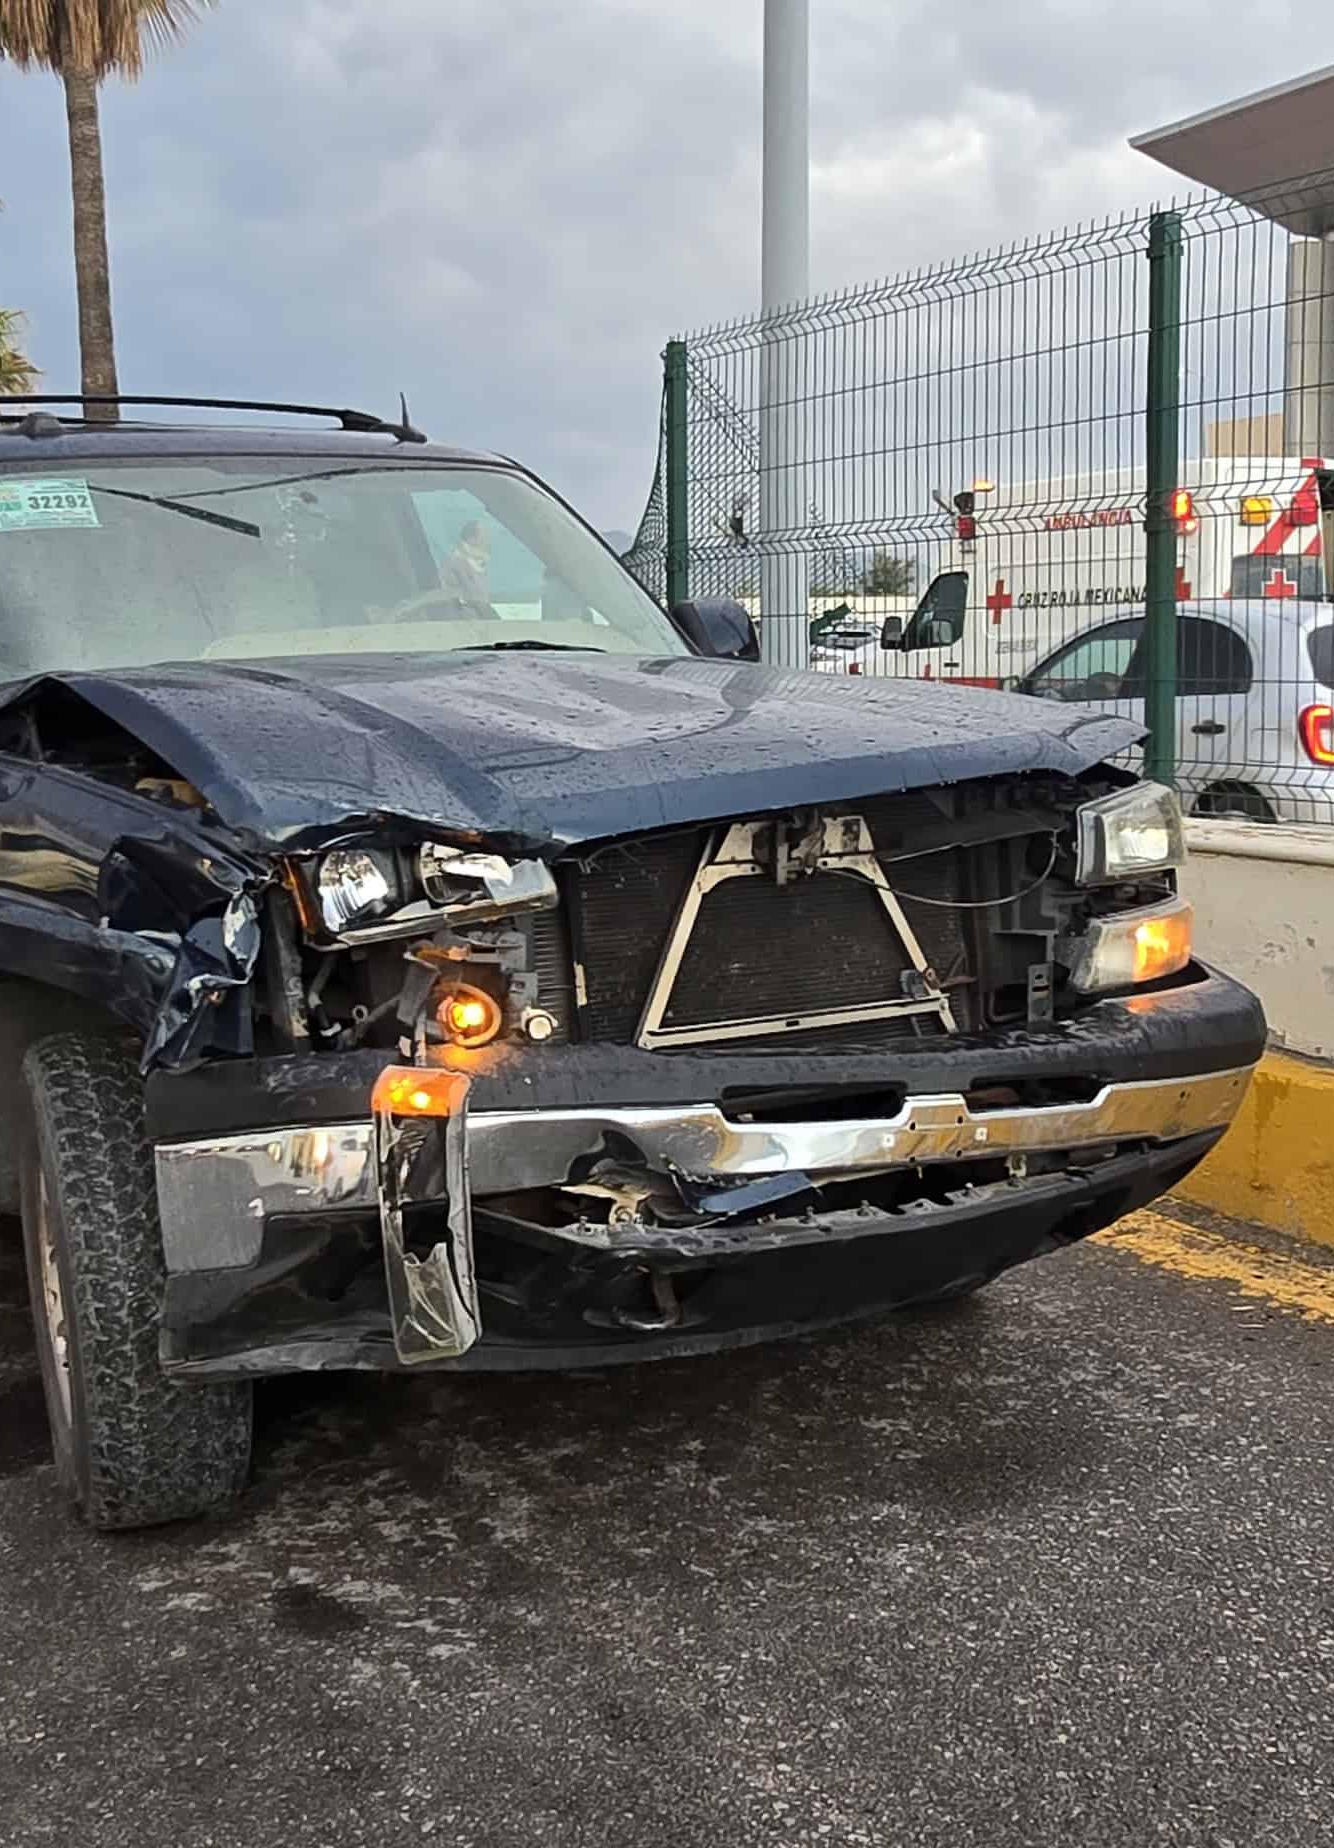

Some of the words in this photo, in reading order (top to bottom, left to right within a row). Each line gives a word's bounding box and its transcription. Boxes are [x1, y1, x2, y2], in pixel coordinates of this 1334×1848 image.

[27, 494, 91, 510] 32292
[1018, 592, 1047, 609] CRUZ
[1049, 589, 1081, 607] ROJA
